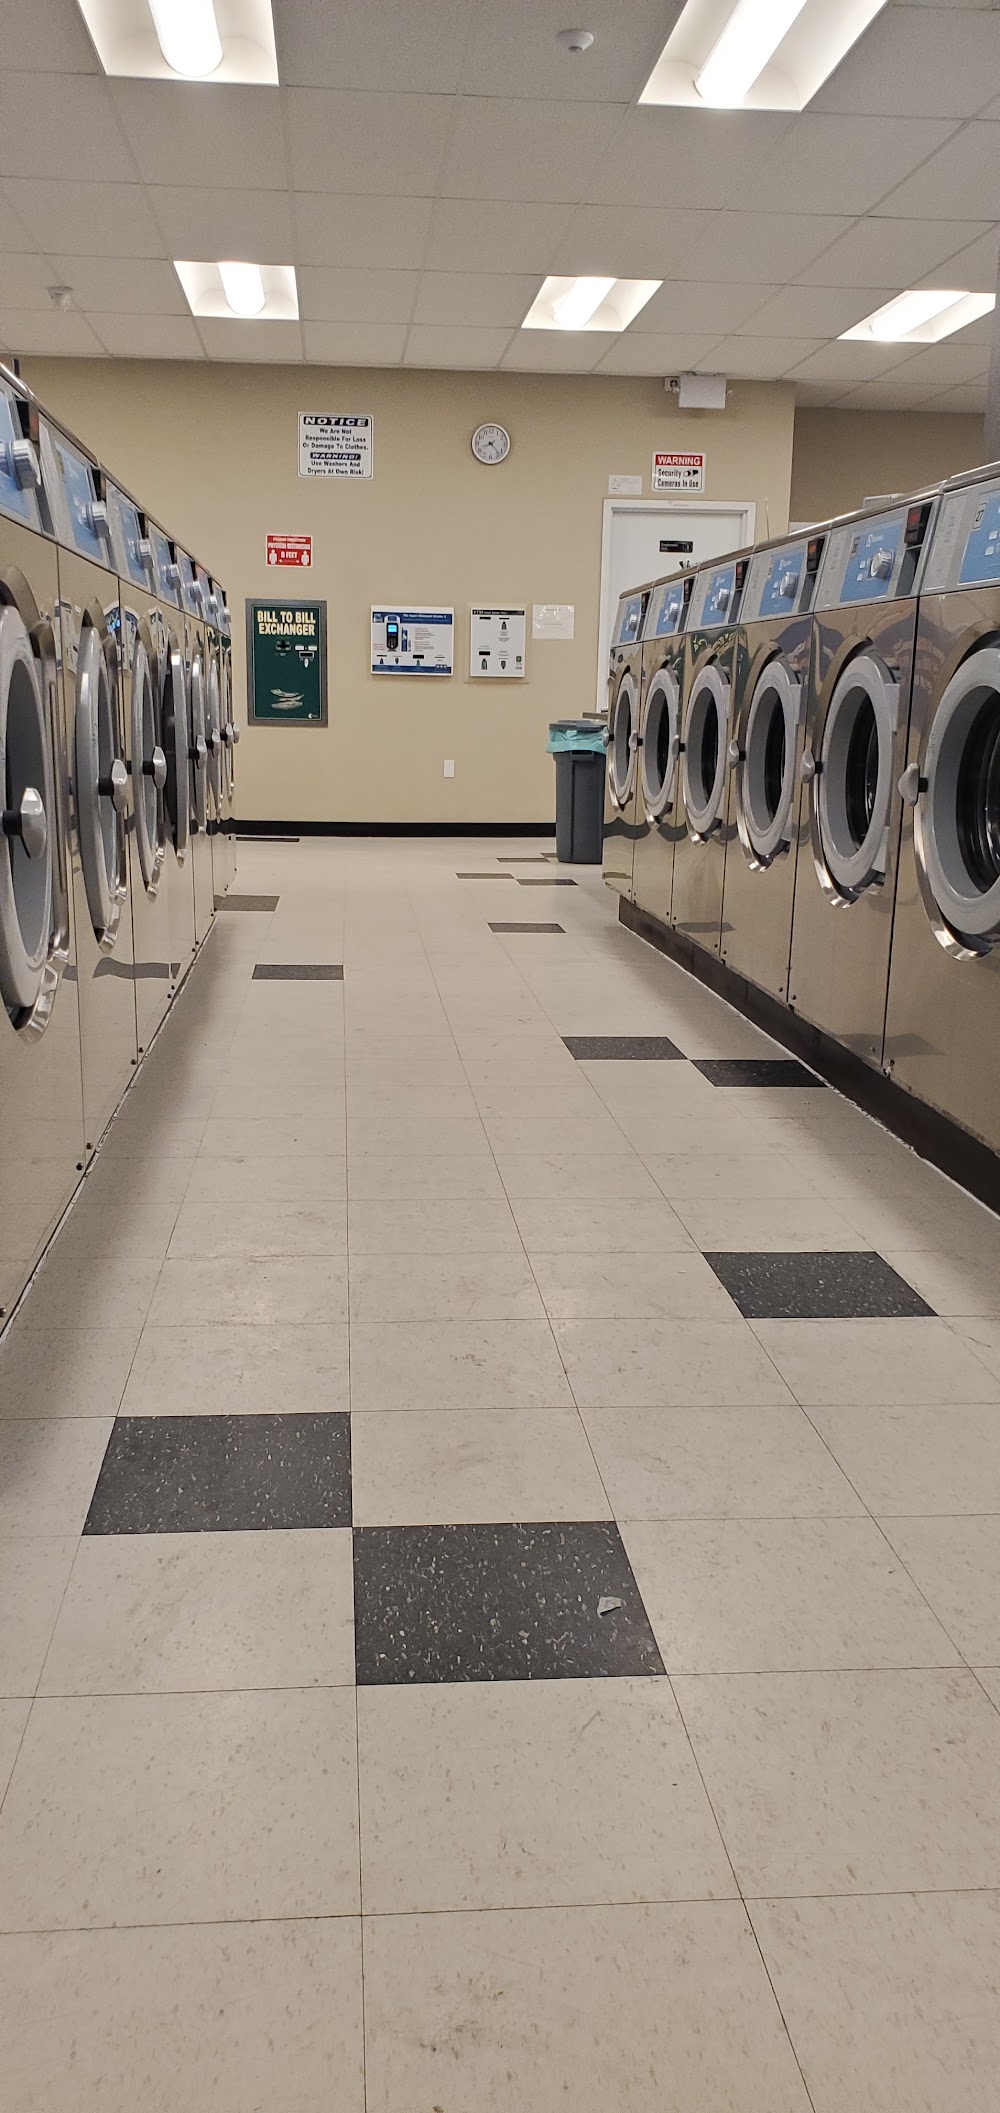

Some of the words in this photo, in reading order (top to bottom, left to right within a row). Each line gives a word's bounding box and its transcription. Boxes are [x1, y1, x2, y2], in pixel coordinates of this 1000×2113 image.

[305, 417, 367, 426] NOTICE
[657, 455, 701, 466] WARNING
[658, 469, 682, 478] Security
[658, 479, 680, 488] Cameras
[689, 480, 699, 488] Use
[257, 610, 278, 623] BILL
[280, 611, 293, 623] TO
[295, 611, 316, 624] BILL
[259, 623, 315, 636] EXCHANGER
